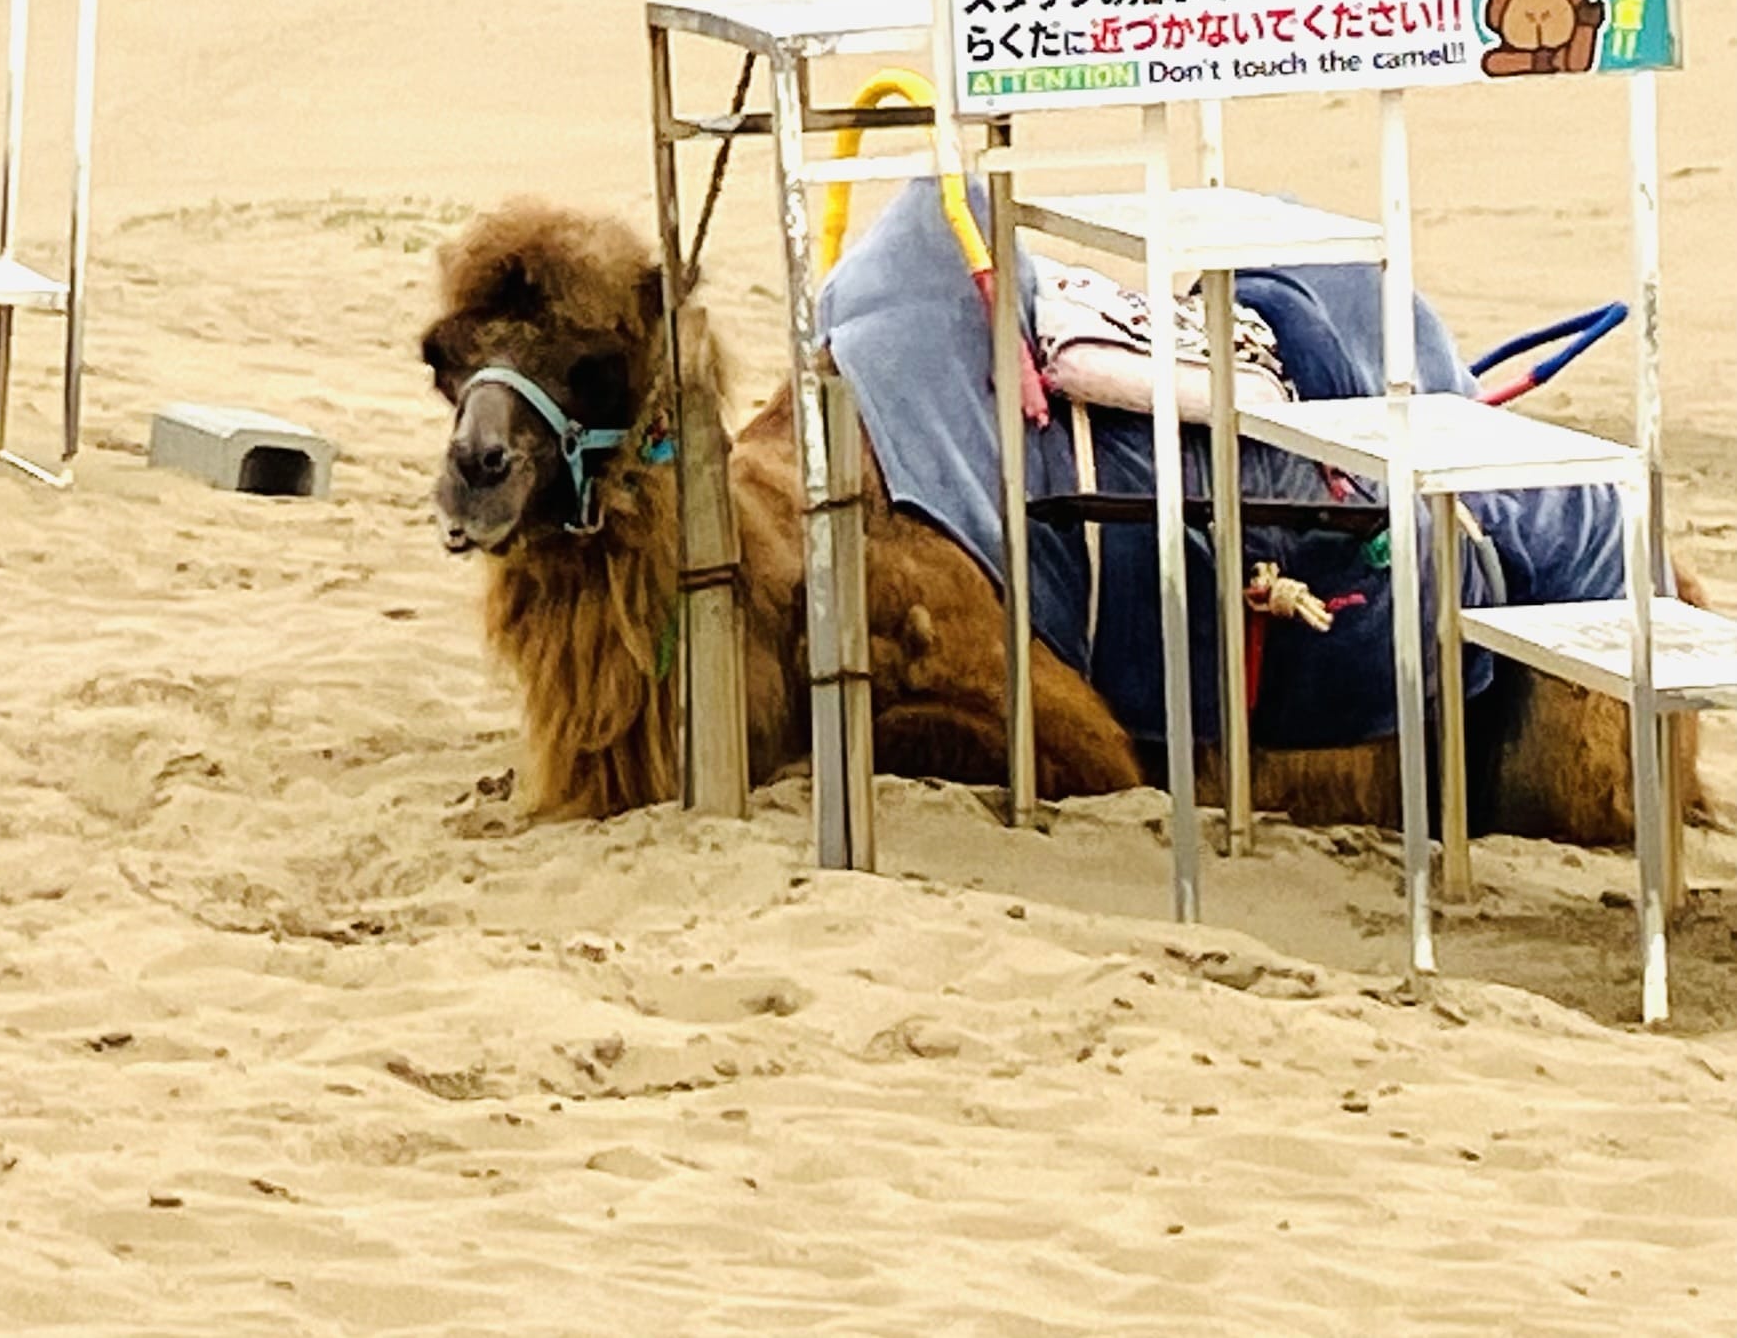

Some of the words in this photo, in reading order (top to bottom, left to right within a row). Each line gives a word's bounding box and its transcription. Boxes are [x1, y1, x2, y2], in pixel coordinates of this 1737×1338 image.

[971, 63, 1136, 93] ATTENTION
[1149, 59, 1221, 84] Don't
[1234, 51, 1307, 78] touch
[1319, 48, 1362, 73] the
